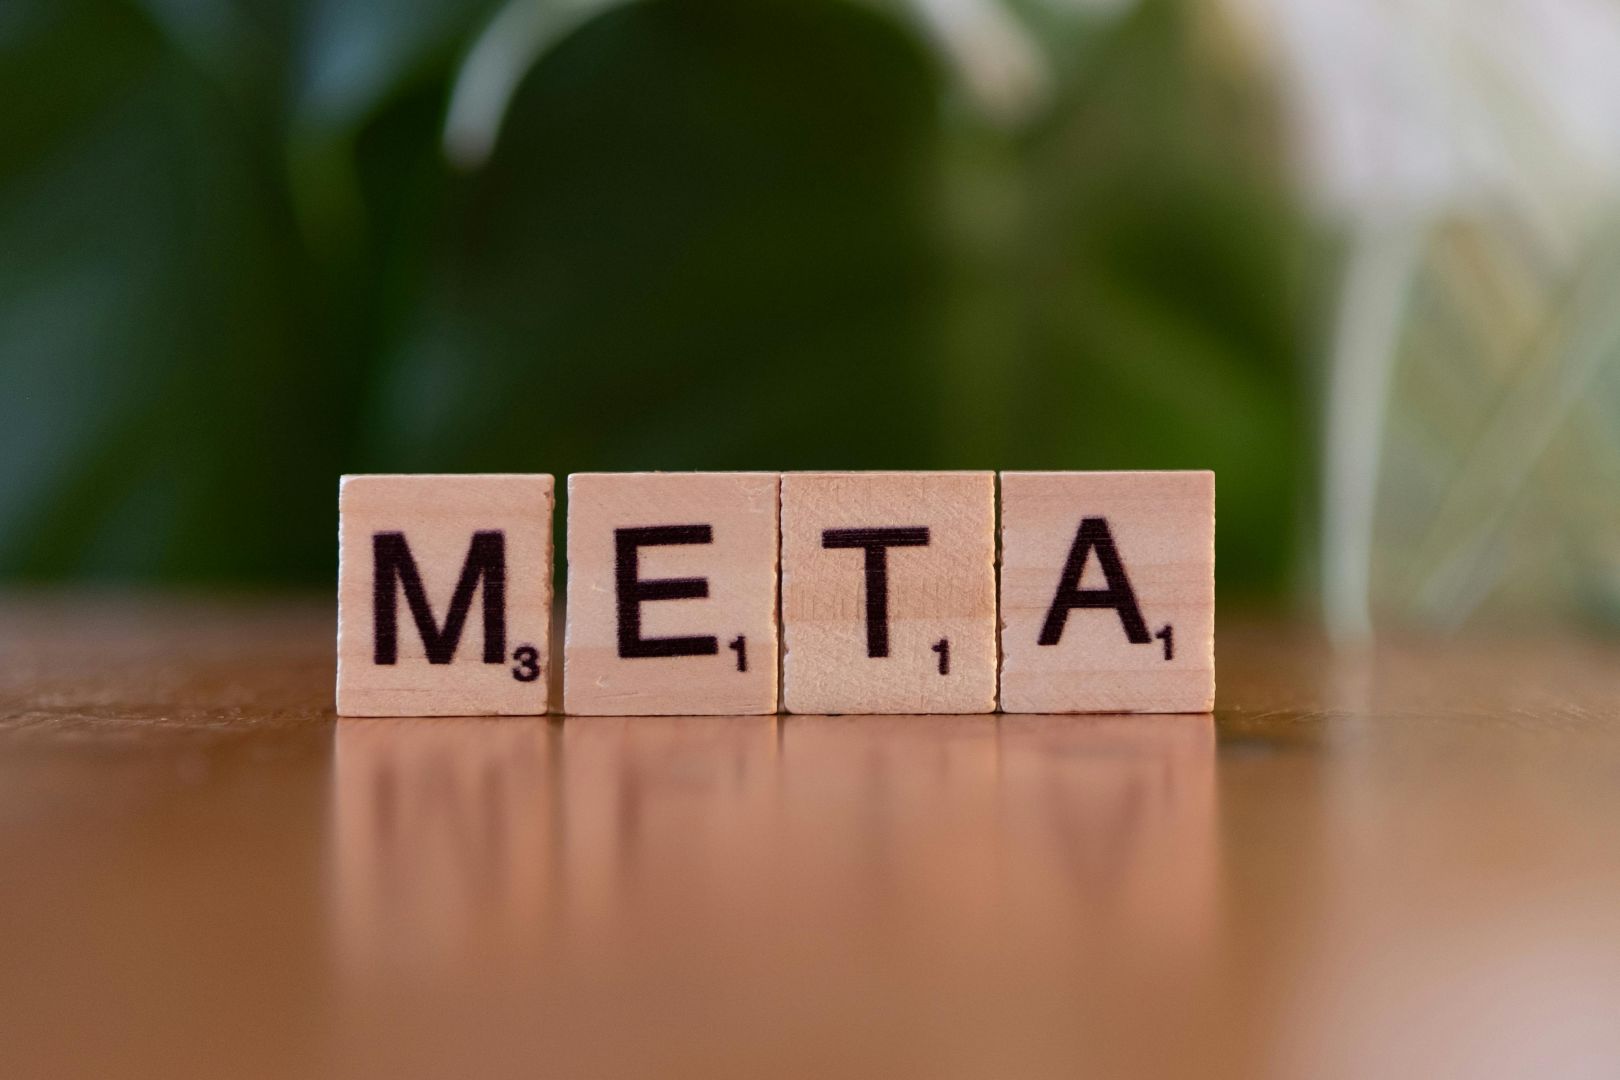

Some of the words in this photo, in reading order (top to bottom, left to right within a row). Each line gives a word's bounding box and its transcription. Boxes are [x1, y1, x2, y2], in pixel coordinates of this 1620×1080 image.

[728, 635, 749, 673] 1
[930, 638, 951, 676] 1
[1154, 624, 1175, 661] 1
[511, 645, 542, 684] 3
